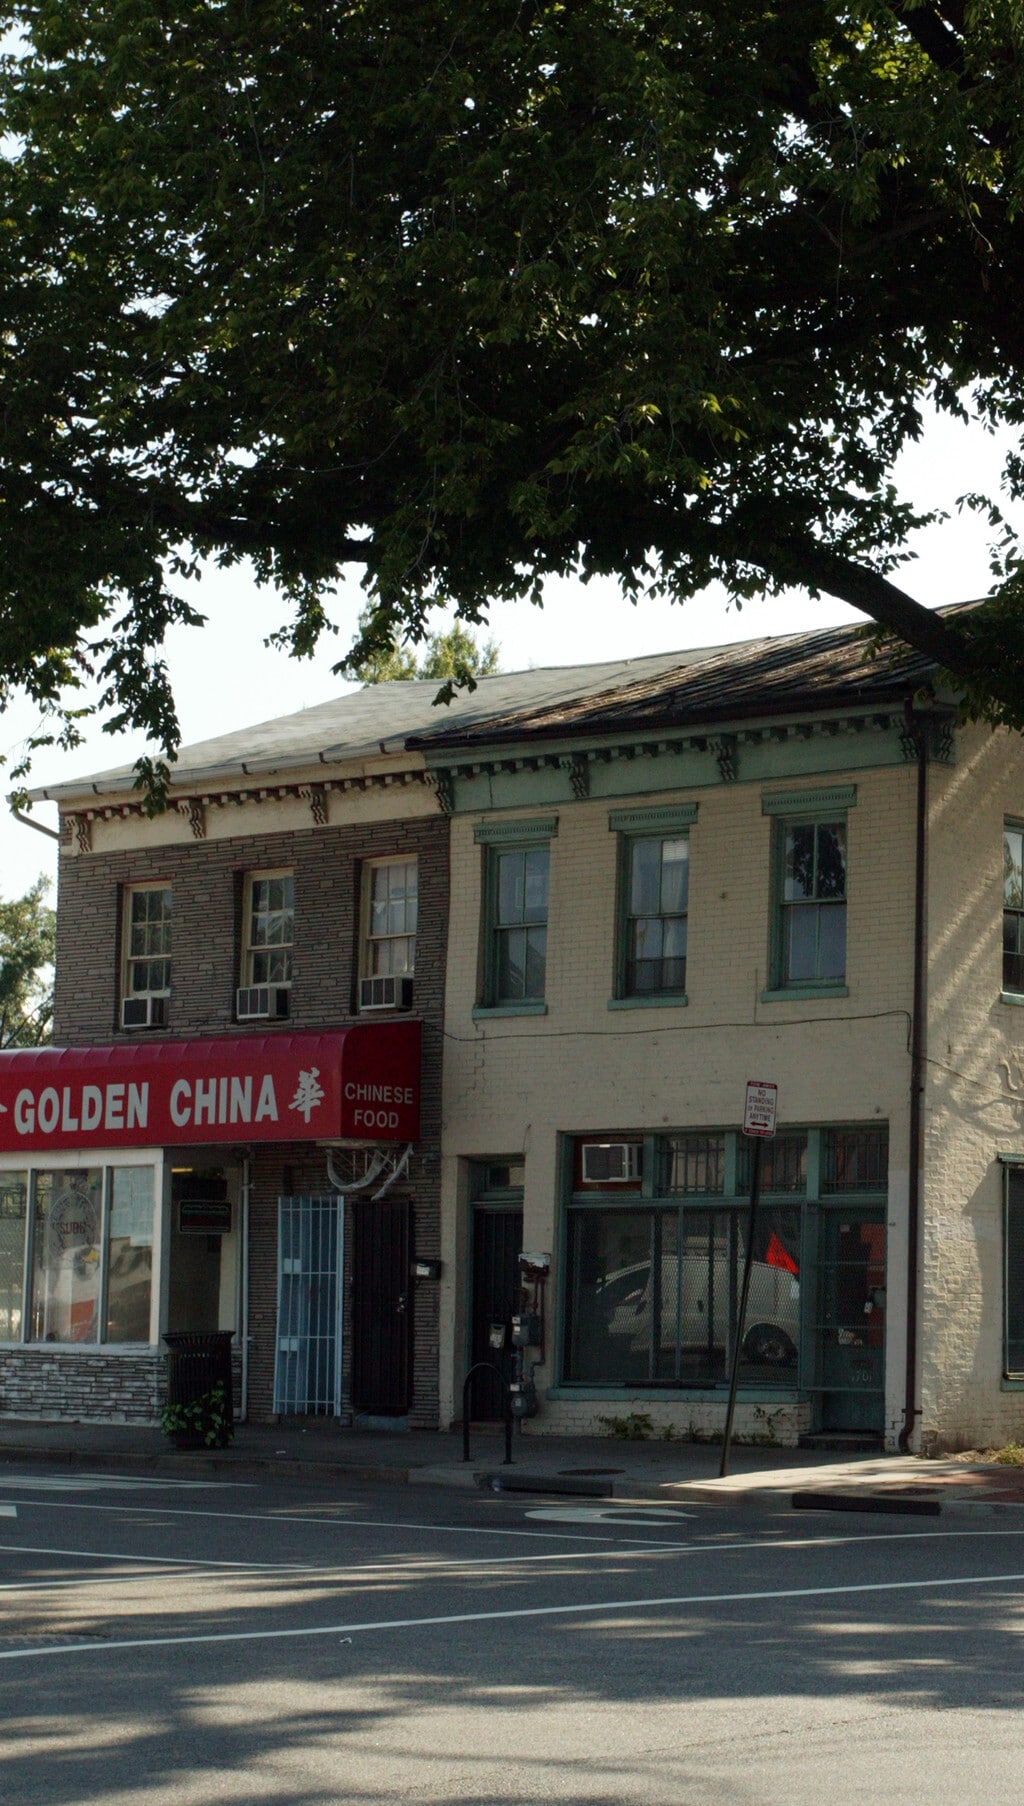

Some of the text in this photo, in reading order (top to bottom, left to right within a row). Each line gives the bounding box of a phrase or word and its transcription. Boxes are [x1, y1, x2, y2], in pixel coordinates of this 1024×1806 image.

[344, 1082, 414, 1104] CHINESE
[757, 1089, 767, 1097] NO
[14, 1074, 279, 1134] GOLDEN CHINA
[749, 1096, 774, 1106] STANDING
[754, 1105, 774, 1114] PARKING
[354, 1109, 399, 1128] FOOD
[749, 1113, 771, 1121] ANYTIME
